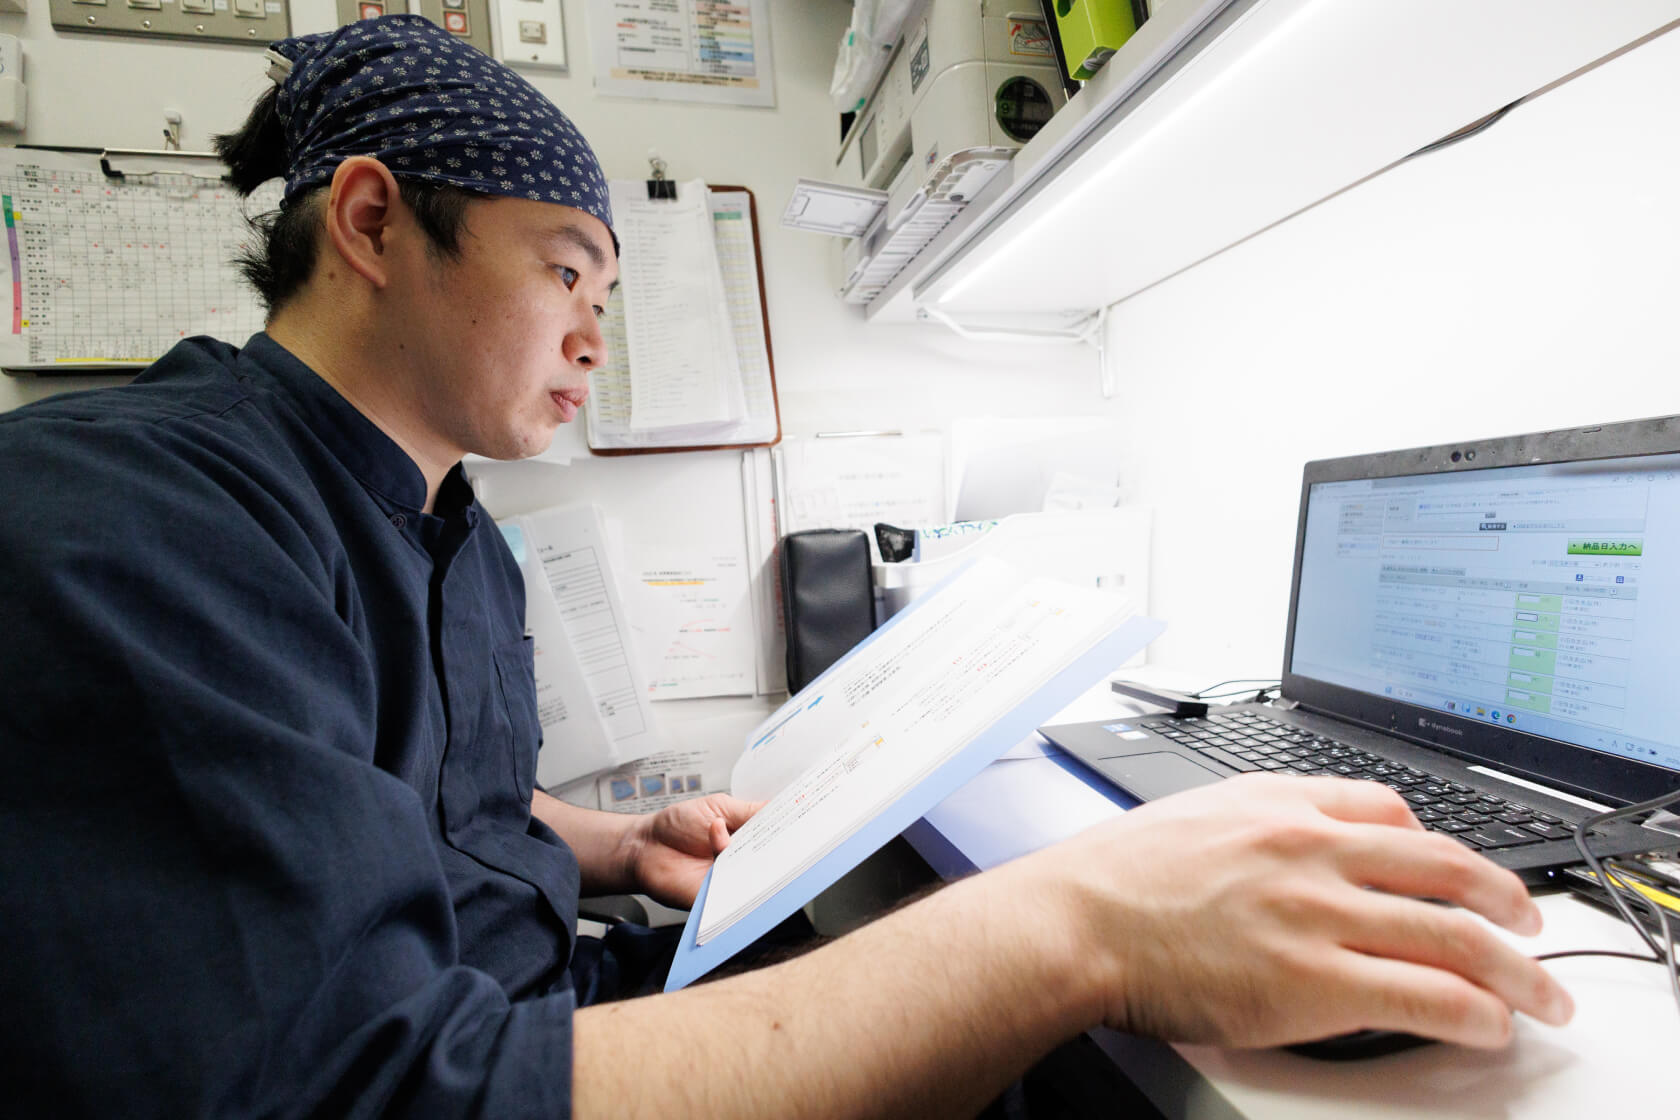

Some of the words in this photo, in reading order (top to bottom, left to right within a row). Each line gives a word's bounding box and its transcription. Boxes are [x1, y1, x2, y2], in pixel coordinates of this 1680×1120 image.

[1582, 542, 1637, 550] 納品日入力へ
[1431, 722, 1463, 736] dynabook
